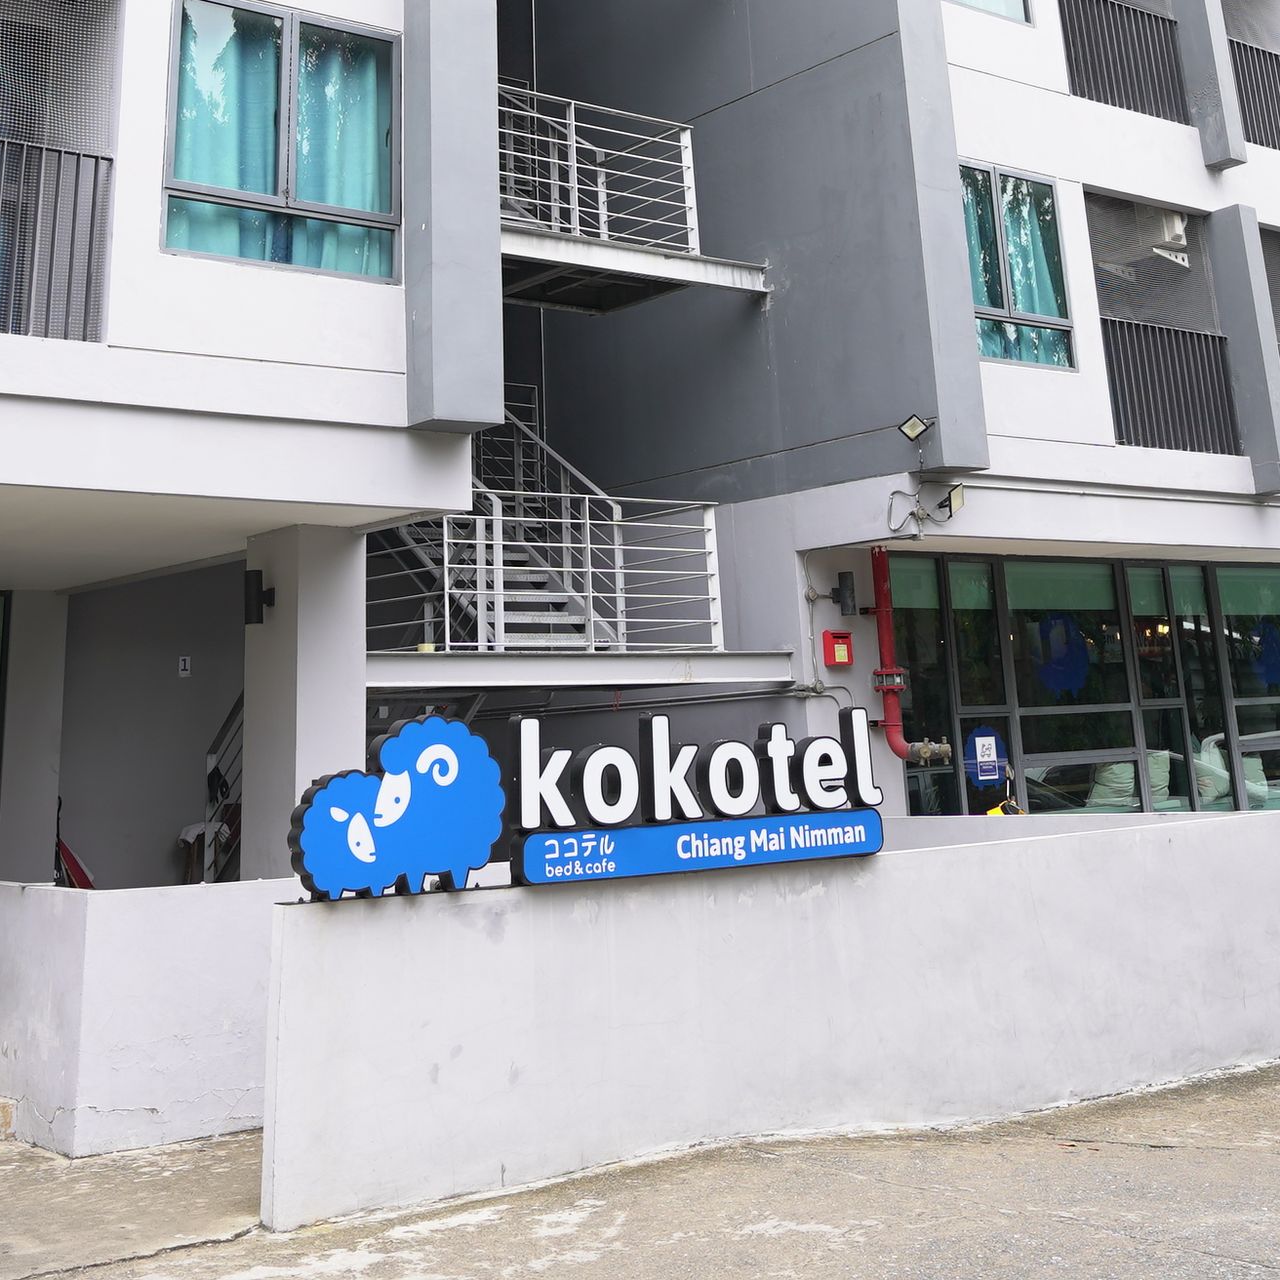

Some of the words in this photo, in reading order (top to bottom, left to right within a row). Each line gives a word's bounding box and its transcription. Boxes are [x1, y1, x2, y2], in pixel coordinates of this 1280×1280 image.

[181, 658, 188, 671] 1
[519, 706, 884, 829] kokotel
[544, 832, 616, 859] ココテル
[675, 832, 747, 862] Chiang
[749, 826, 786, 854] Mai
[789, 823, 867, 850] Nimman
